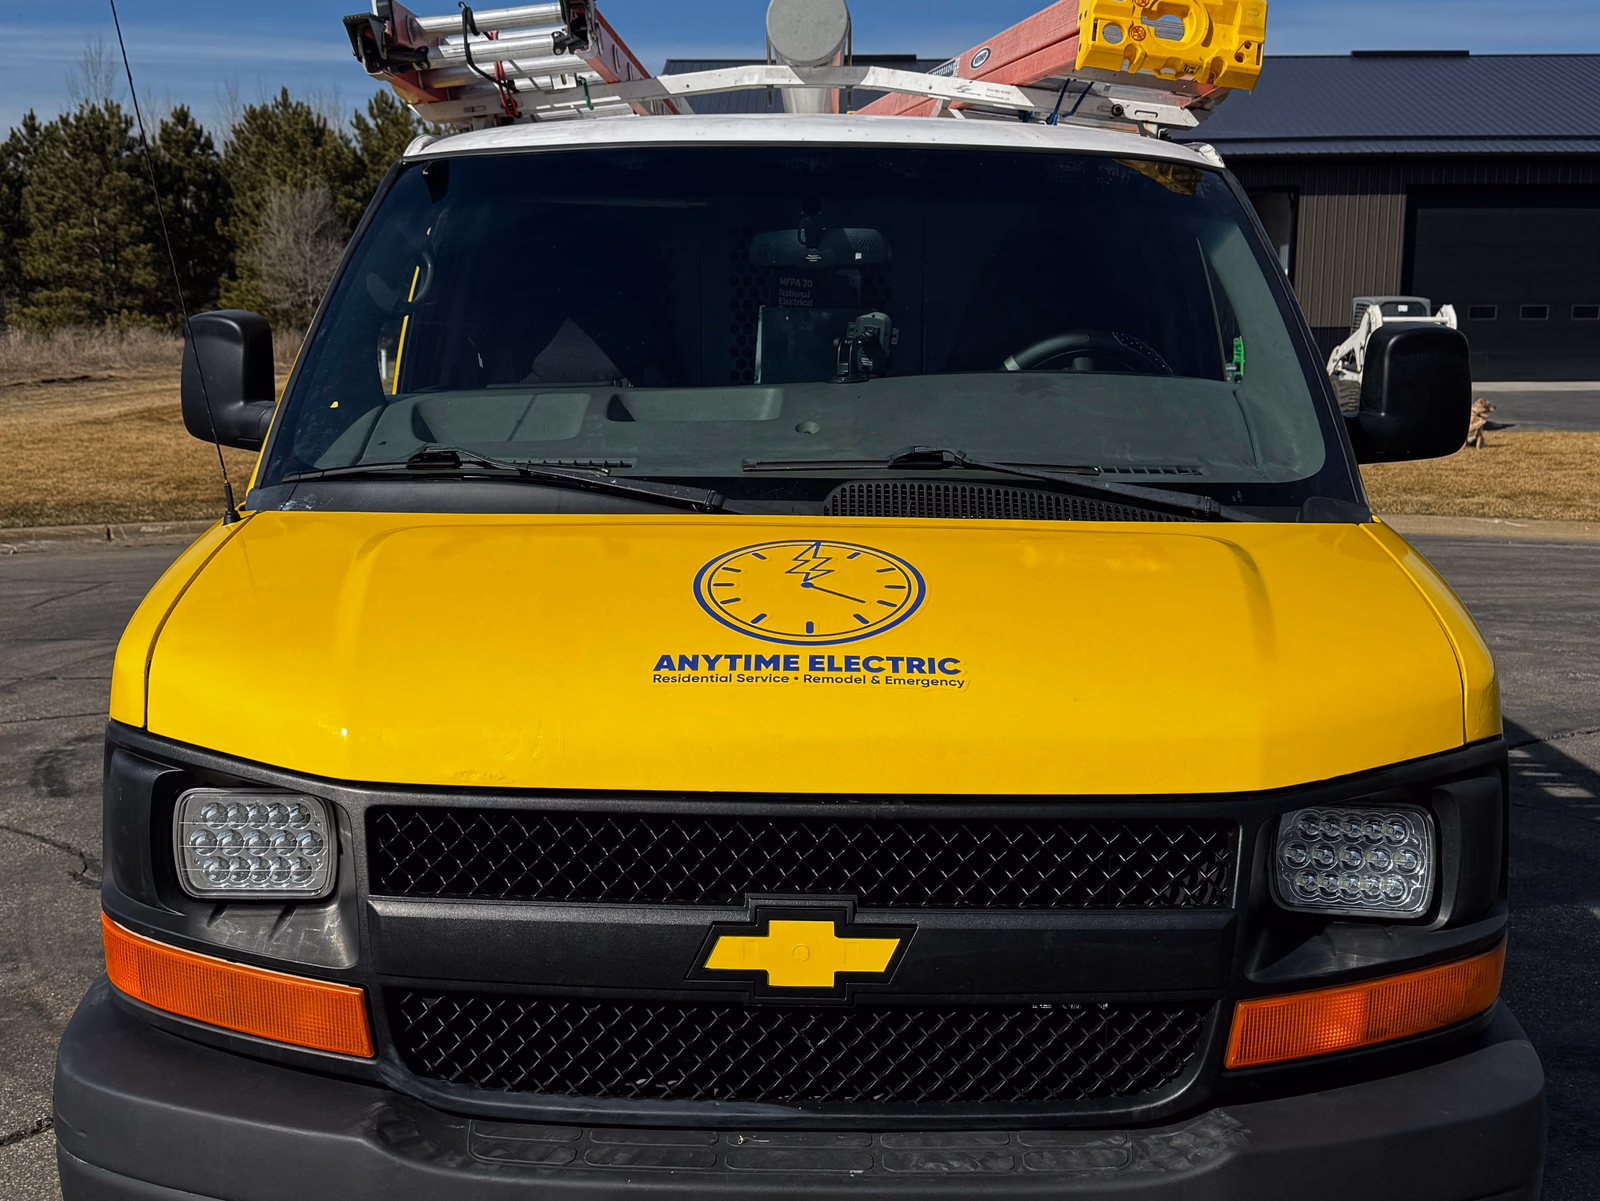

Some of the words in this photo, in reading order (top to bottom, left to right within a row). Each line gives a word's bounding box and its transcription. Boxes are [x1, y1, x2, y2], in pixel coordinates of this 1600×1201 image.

[779, 277, 801, 287] NFPA
[803, 279, 813, 288] 70
[779, 288, 810, 298] National
[778, 297, 813, 306] Electrical
[653, 654, 800, 671] ANYTIME
[808, 655, 961, 675] ELECTRIC
[653, 673, 732, 683] Residential
[737, 674, 789, 683] Service
[803, 674, 866, 684] Remodel
[870, 676, 881, 684] &
[885, 676, 965, 688] Emergency
